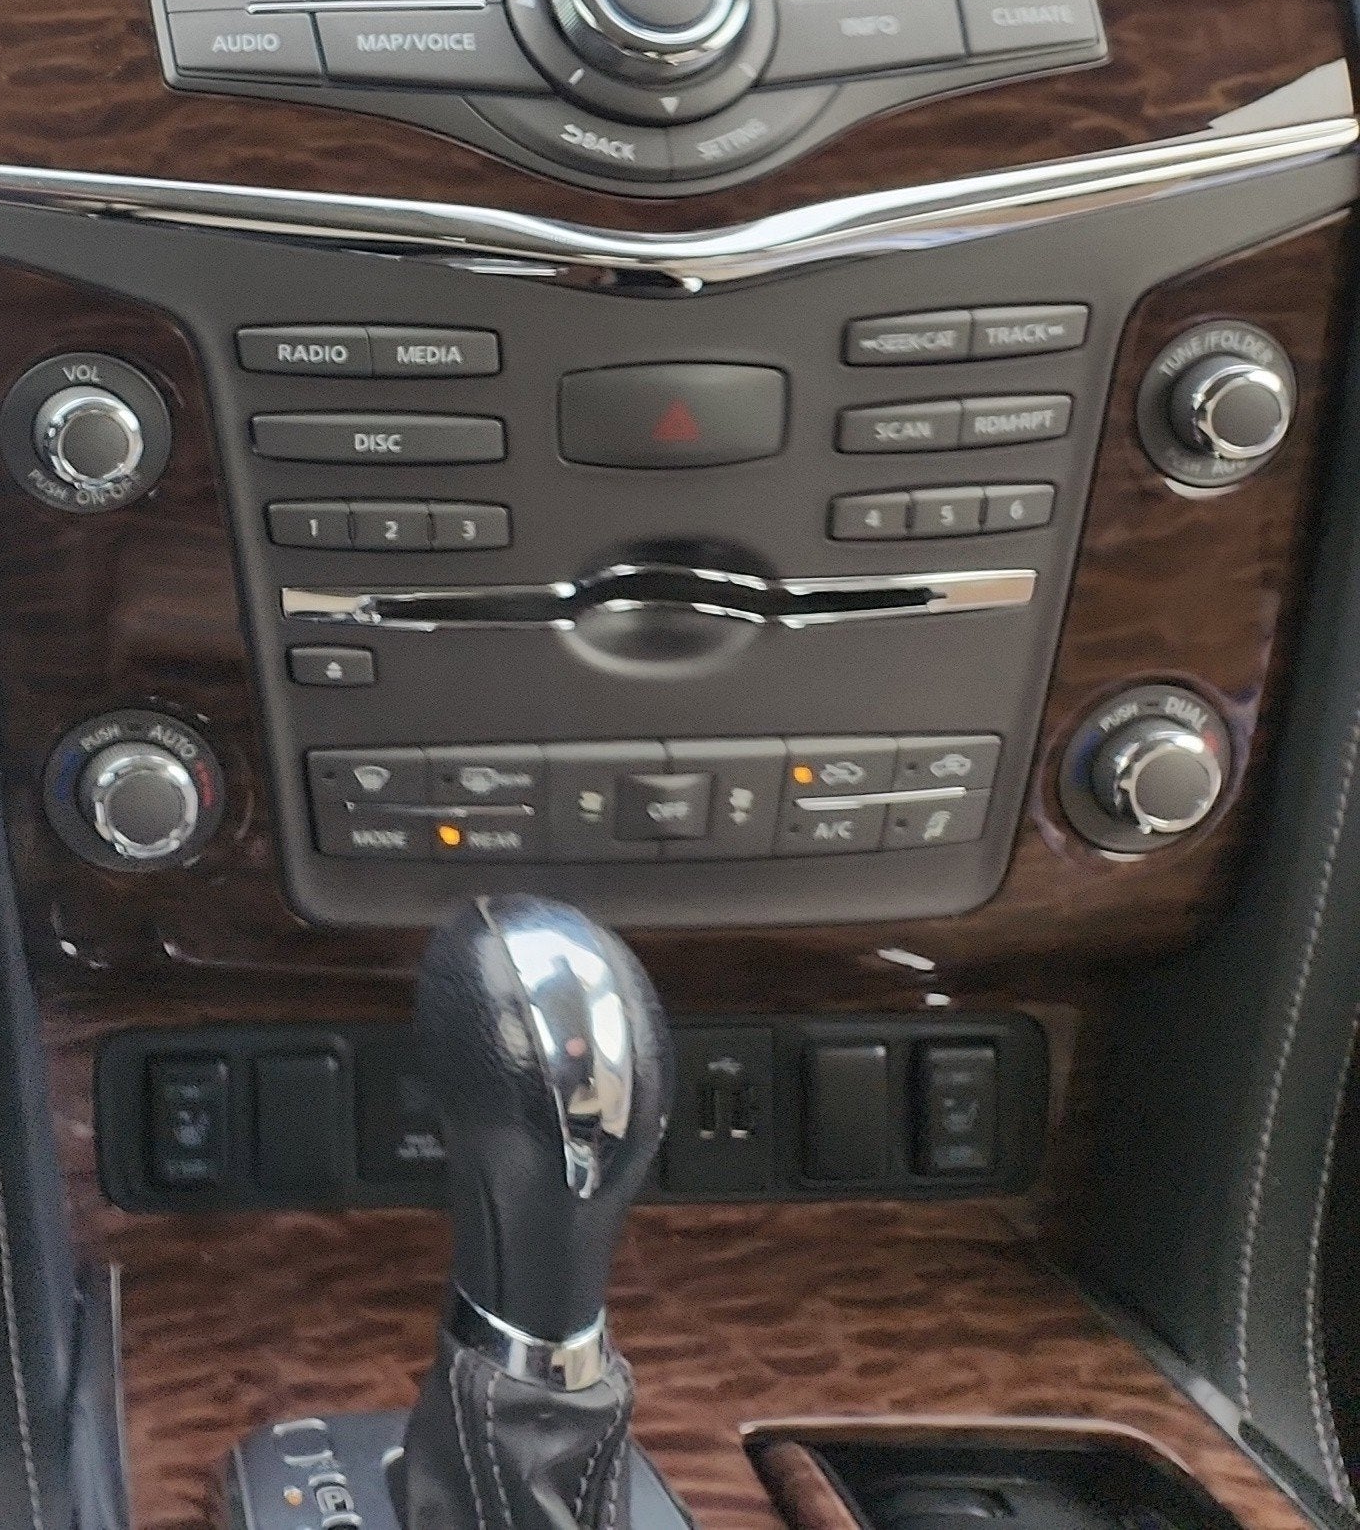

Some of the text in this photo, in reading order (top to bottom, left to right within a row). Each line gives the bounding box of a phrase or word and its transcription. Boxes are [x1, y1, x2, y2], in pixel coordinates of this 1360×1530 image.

[992, 5, 1075, 27] CLIMATE
[212, 32, 280, 53] AUDIO
[356, 32, 476, 51] MAP/VOICE
[985, 323, 1050, 345] TRACK
[278, 343, 348, 365] RADIO
[396, 345, 464, 365] MEDIA
[62, 365, 101, 383] VOL
[875, 421, 934, 442] SCAN
[353, 433, 402, 453] DISC
[27, 469, 68, 500] PUSH
[308, 519, 319, 537] 1
[384, 520, 399, 539] 2
[462, 520, 477, 539] 3
[1164, 695, 1210, 732] DUAL
[149, 724, 198, 760] AUTO
